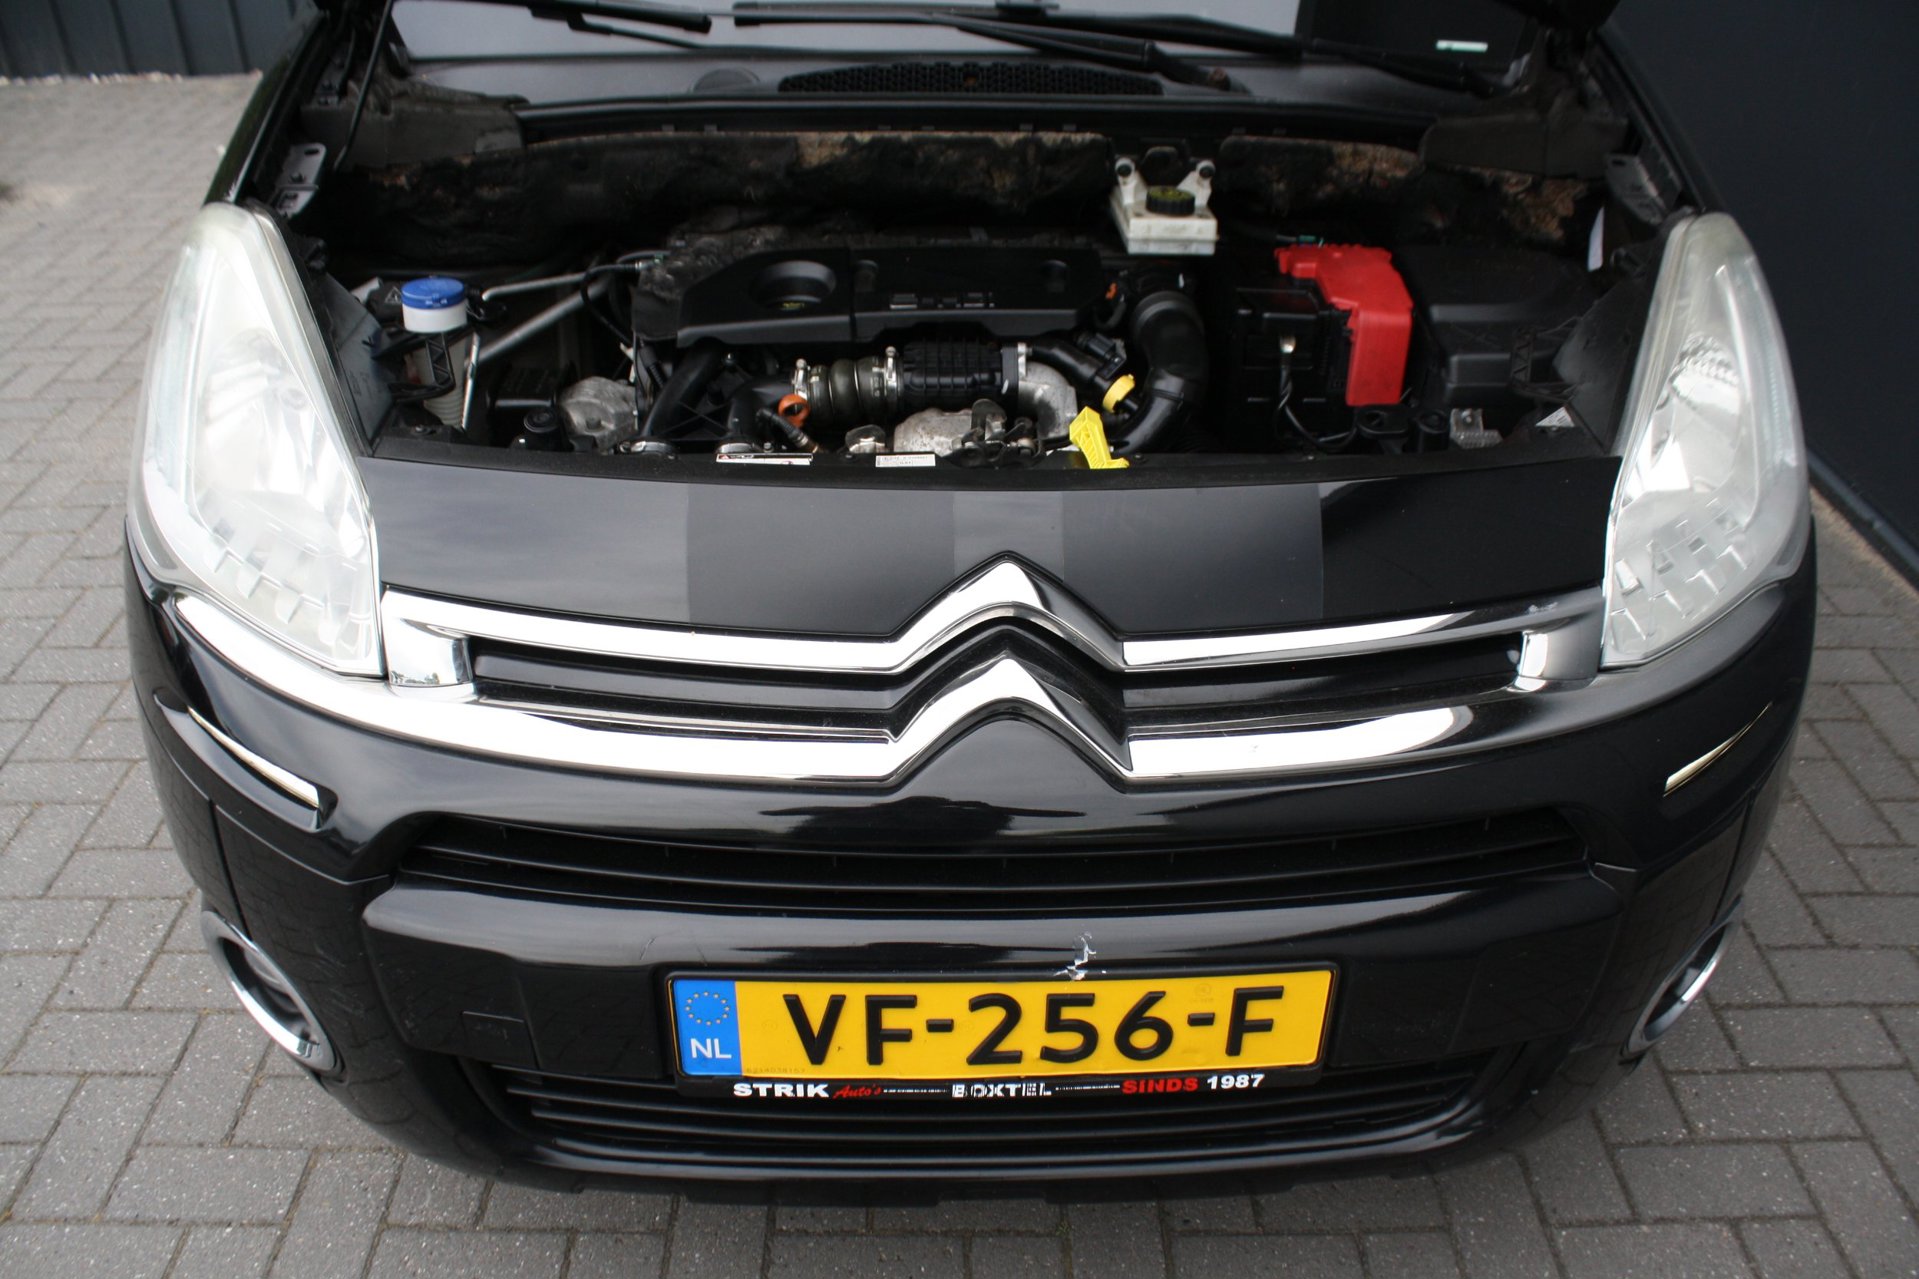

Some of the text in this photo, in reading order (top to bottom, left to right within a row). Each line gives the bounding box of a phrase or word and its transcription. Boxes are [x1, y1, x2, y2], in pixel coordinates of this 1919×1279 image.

[782, 985, 1285, 1066] VF-256-F
[690, 1038, 732, 1059] NL
[733, 1083, 829, 1097] STRIK
[832, 1085, 881, 1099] Auto's
[1122, 1077, 1198, 1094] SINDS
[1207, 1074, 1265, 1089] 1987
